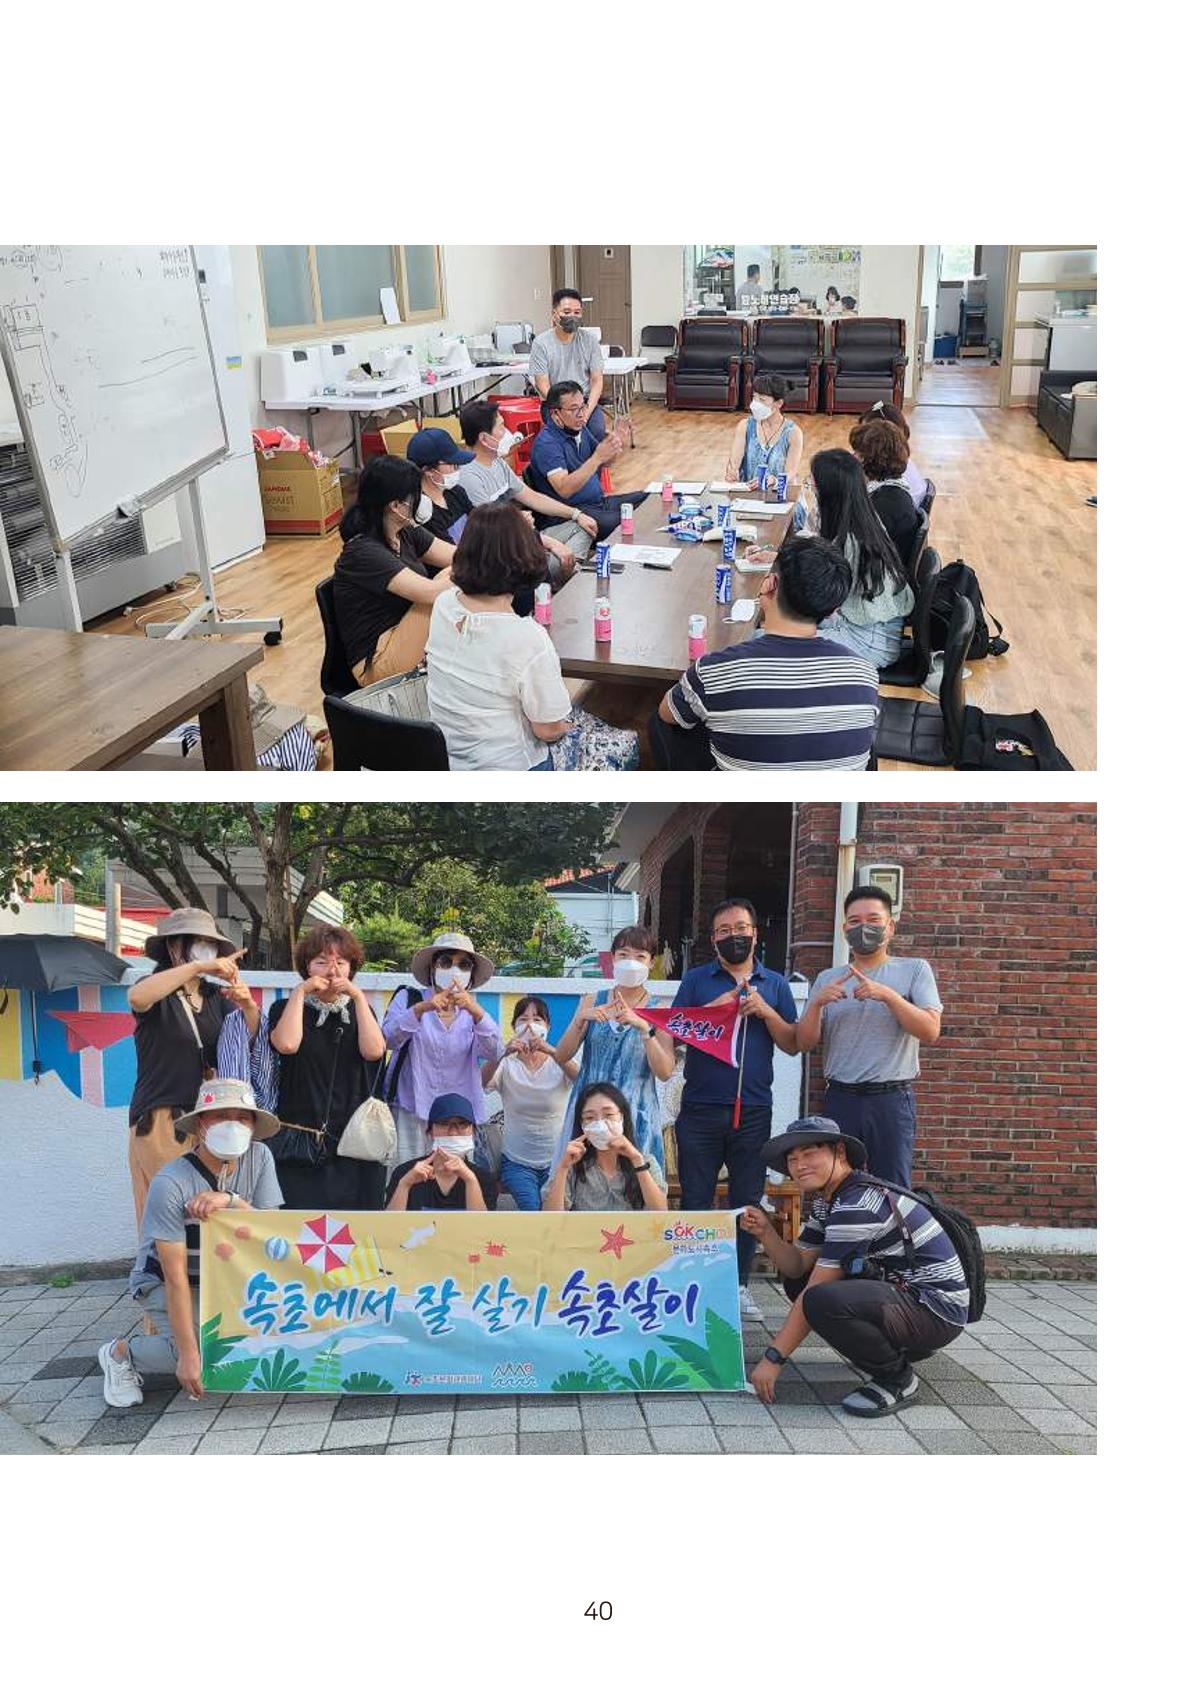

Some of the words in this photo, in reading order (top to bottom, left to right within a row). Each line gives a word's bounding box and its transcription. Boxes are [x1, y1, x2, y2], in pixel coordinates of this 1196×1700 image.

[667, 1013, 725, 1041] 속초살이
[243, 1271, 396, 1335] 속초에서
[414, 1278, 462, 1335] 잘
[472, 1276, 549, 1333] 살기
[558, 1269, 700, 1336] 속초살이
